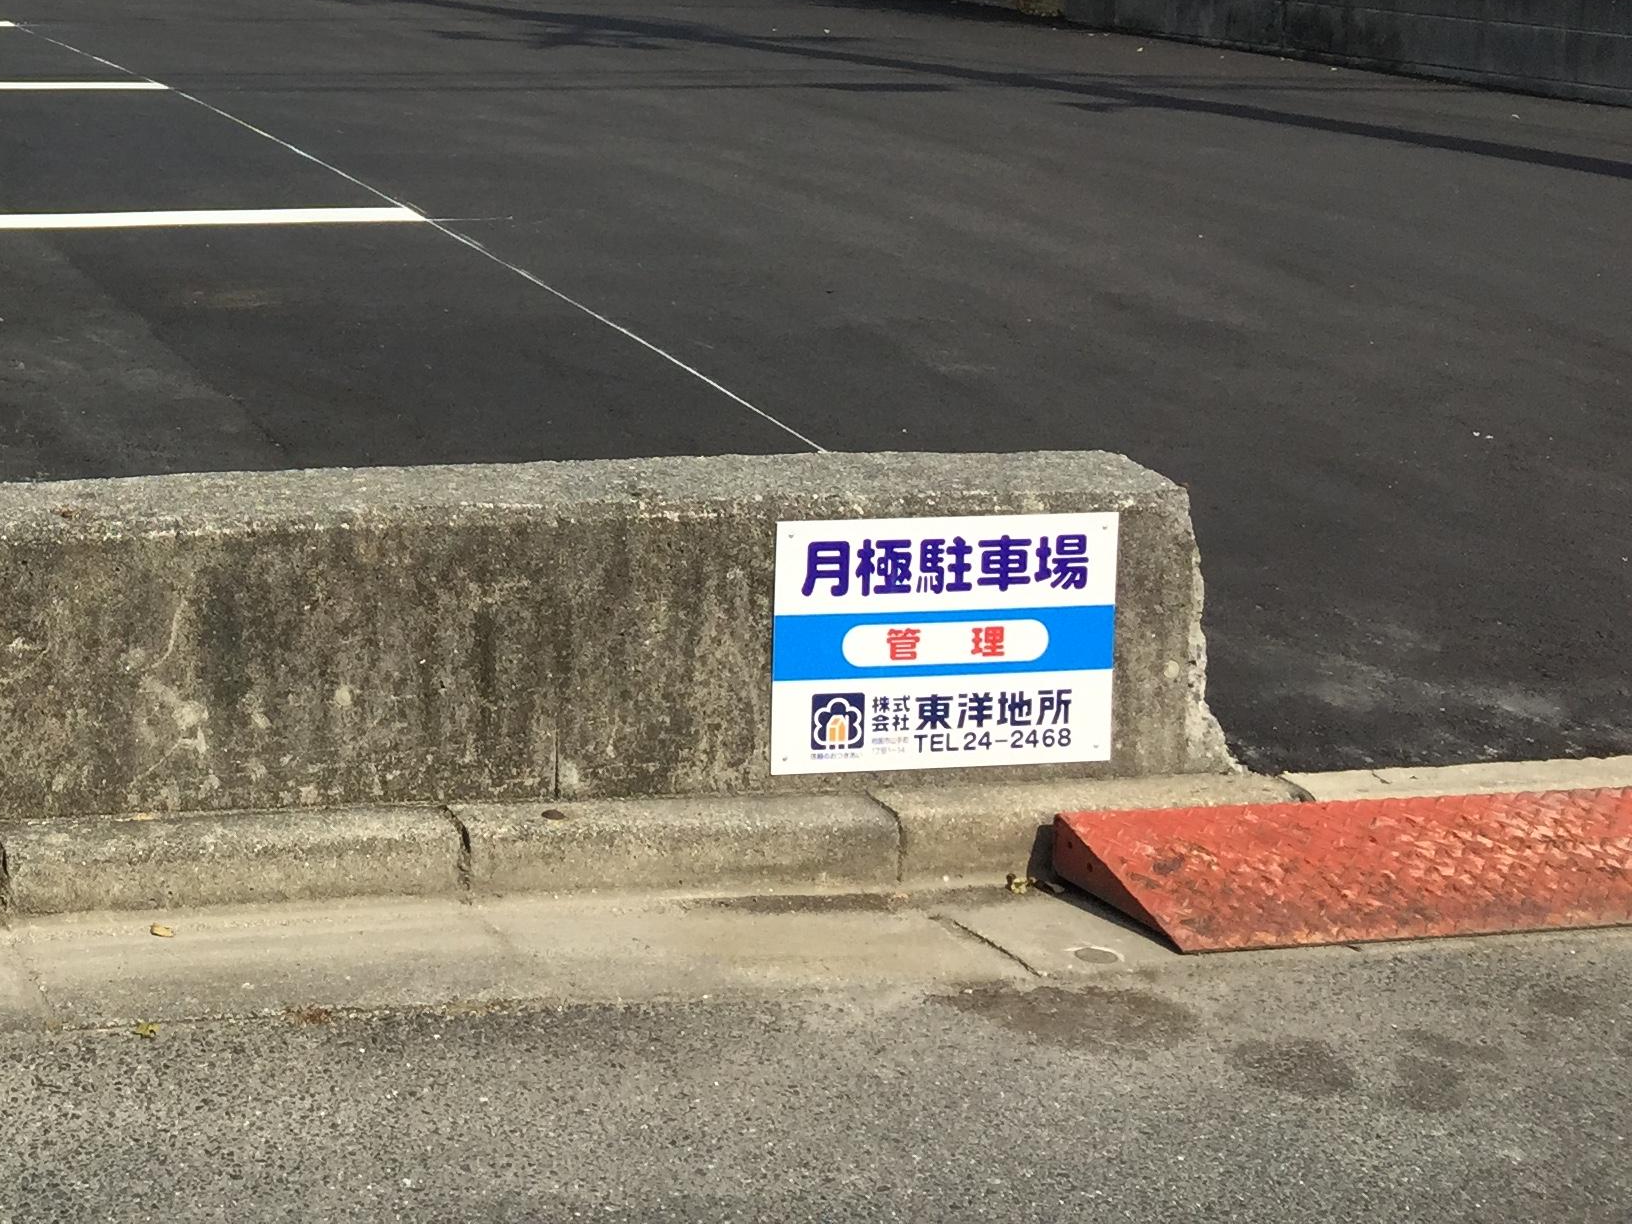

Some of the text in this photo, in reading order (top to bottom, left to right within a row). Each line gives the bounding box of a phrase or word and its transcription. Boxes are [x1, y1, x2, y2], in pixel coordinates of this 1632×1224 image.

[801, 534, 1089, 597] 月極駐車場
[886, 626, 1005, 661] 管理
[915, 689, 1072, 730] 東洋地所
